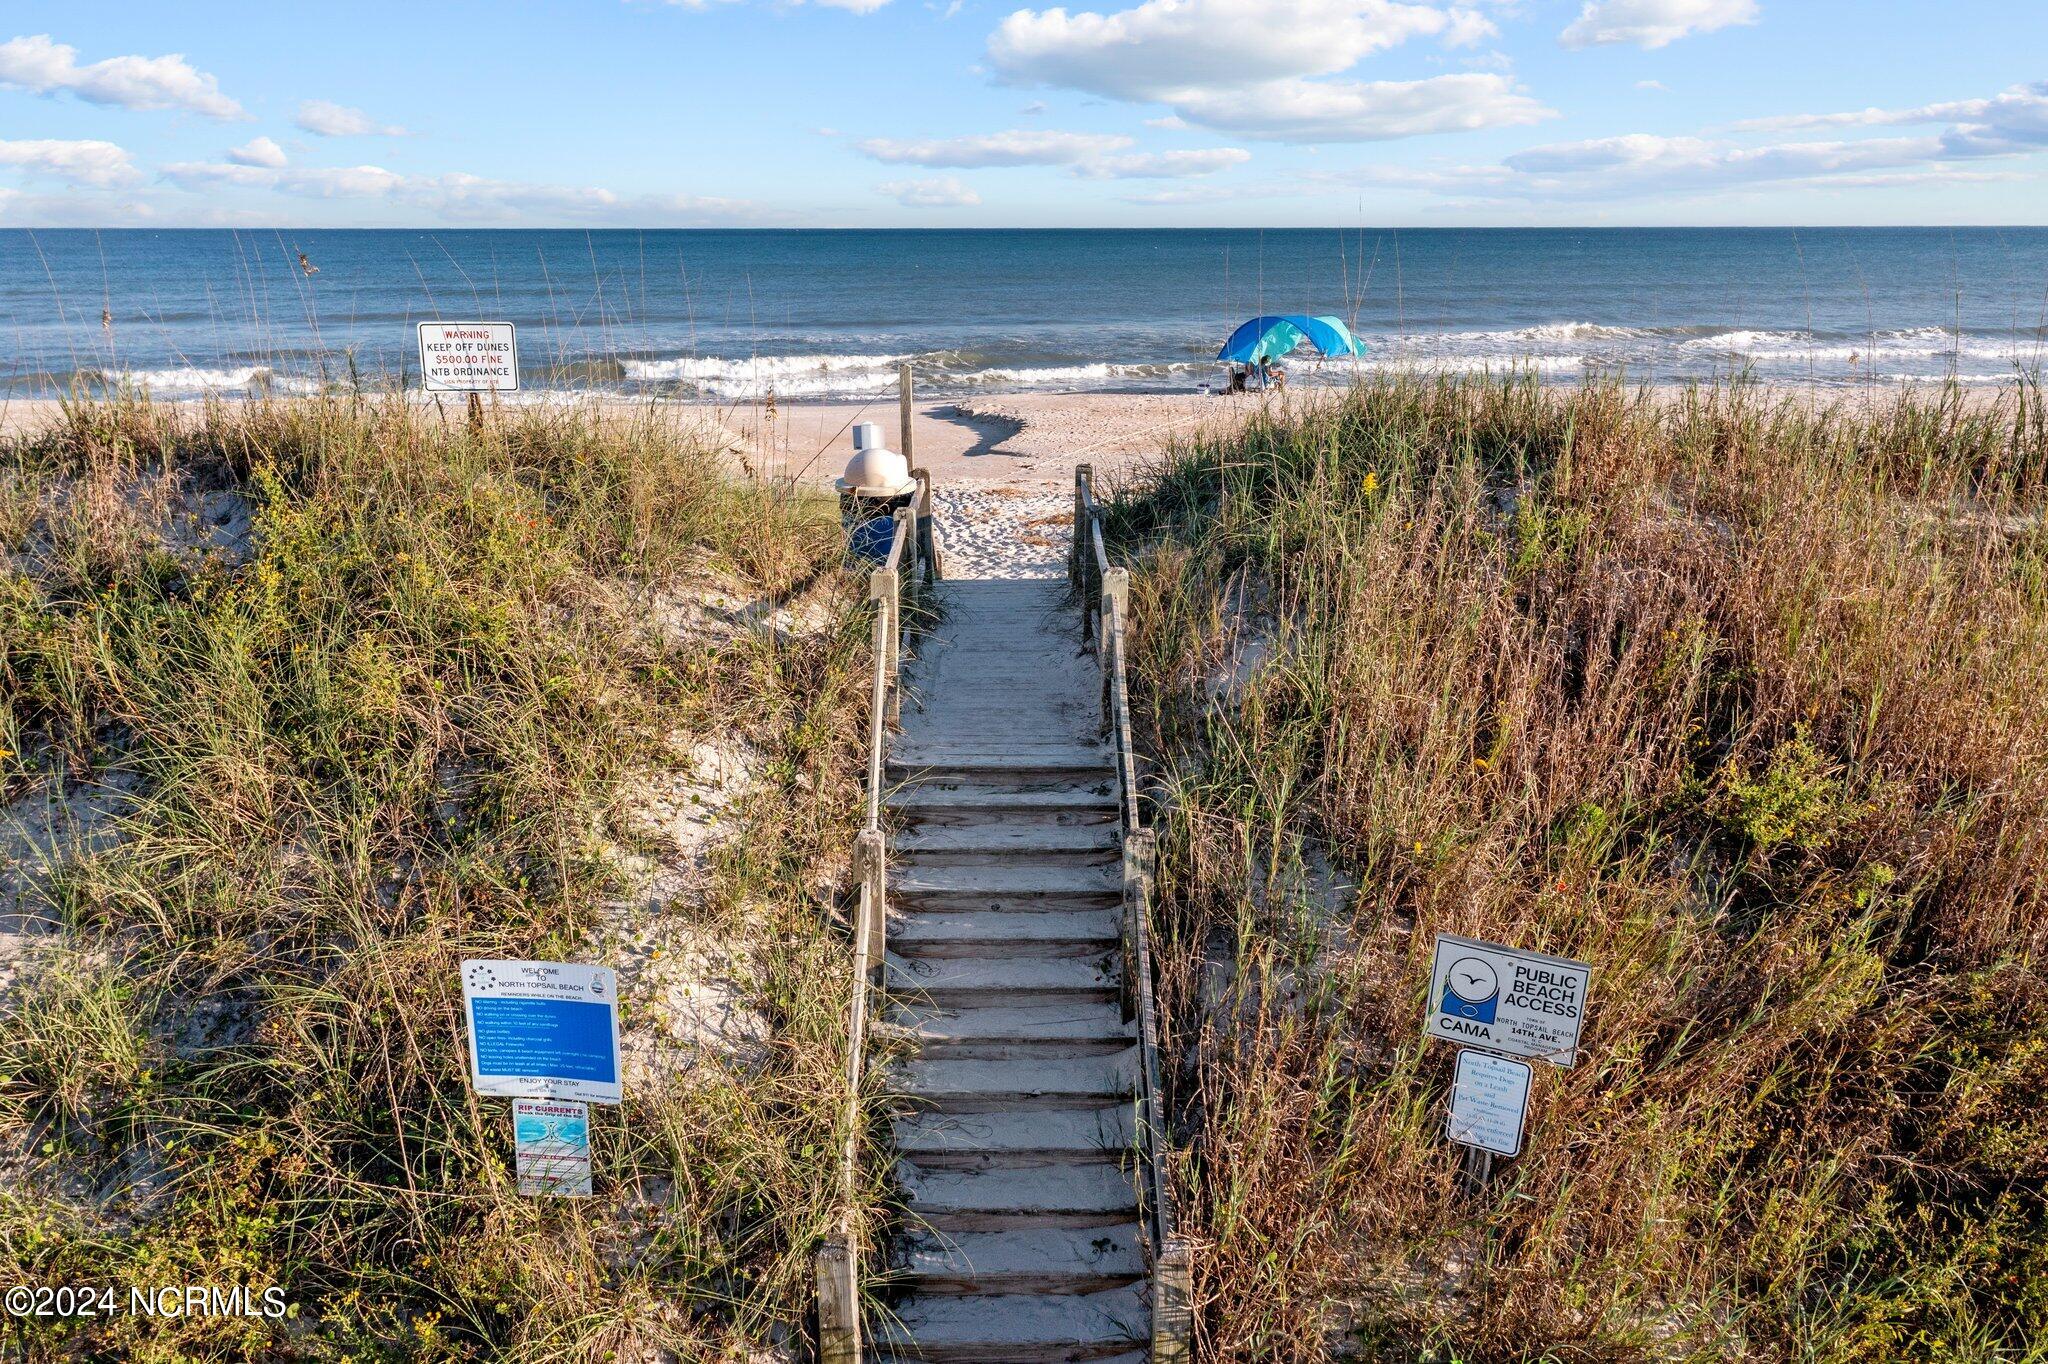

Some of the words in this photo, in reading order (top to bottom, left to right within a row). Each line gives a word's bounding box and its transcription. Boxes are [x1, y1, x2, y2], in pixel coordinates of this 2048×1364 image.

[445, 330, 489, 339] WARNING
[427, 343, 451, 351] KEEP
[456, 343, 473, 351] OFF
[477, 343, 509, 351] DUNES
[436, 355, 477, 364] $500.00
[432, 368, 450, 376] NTB
[454, 368, 509, 376] ORDINANCE
[521, 967, 560, 976] WELCOME
[1515, 965, 1578, 989] PUBLIC
[527, 982, 557, 990] TOPSAIL
[1512, 980, 1575, 1004] BEACH
[1504, 993, 1578, 1018] ACCESS
[1440, 1017, 1491, 1040] CAMA
[1496, 1016, 1518, 1026] NORTH
[1522, 1022, 1548, 1033] TOPSAIL
[1552, 1028, 1574, 1038] BEACH
[1511, 1028, 1537, 1038] 14TH.
[1538, 1034, 1561, 1044] AVE.
[1508, 1037, 1530, 1046] COASTAL
[1524, 1045, 1548, 1053] PROGRAM
[1464, 1058, 1481, 1068] North
[1483, 1062, 1506, 1072] Topsail
[1508, 1068, 1526, 1078] Beach
[1472, 1070, 1498, 1080] Requires
[1500, 1076, 1515, 1085] Dogs
[1490, 1083, 1508, 1092] Leash
[1470, 1096, 1488, 1106] Waste
[1490, 1102, 1519, 1114] Removed
[535, 1106, 583, 1114] CURRENTS
[1487, 1128, 1514, 1138] enforced
